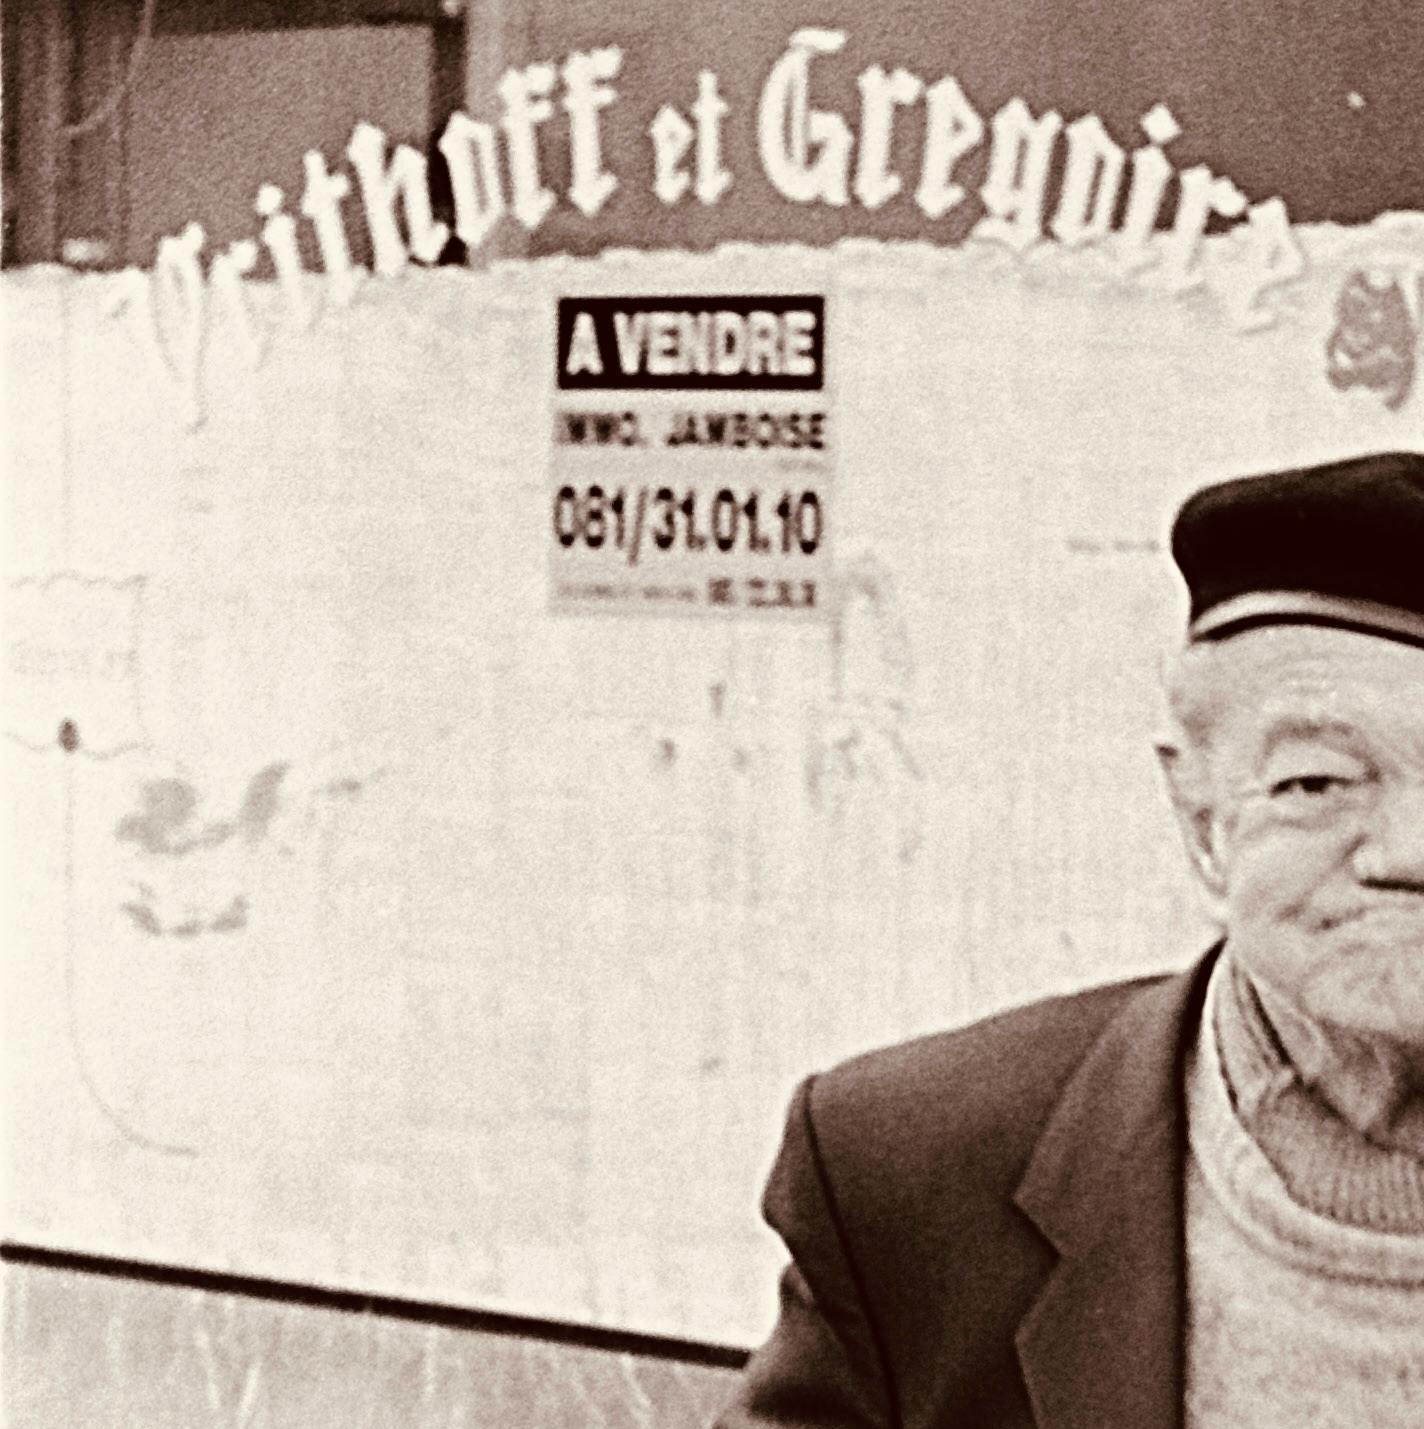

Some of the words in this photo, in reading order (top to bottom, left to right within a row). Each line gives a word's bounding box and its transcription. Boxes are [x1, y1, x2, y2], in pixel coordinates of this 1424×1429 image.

[650, 69, 733, 205] et
[565, 310, 604, 376] A
[612, 309, 817, 377] VENDRE
[553, 485, 822, 566] 081/31.01.10
